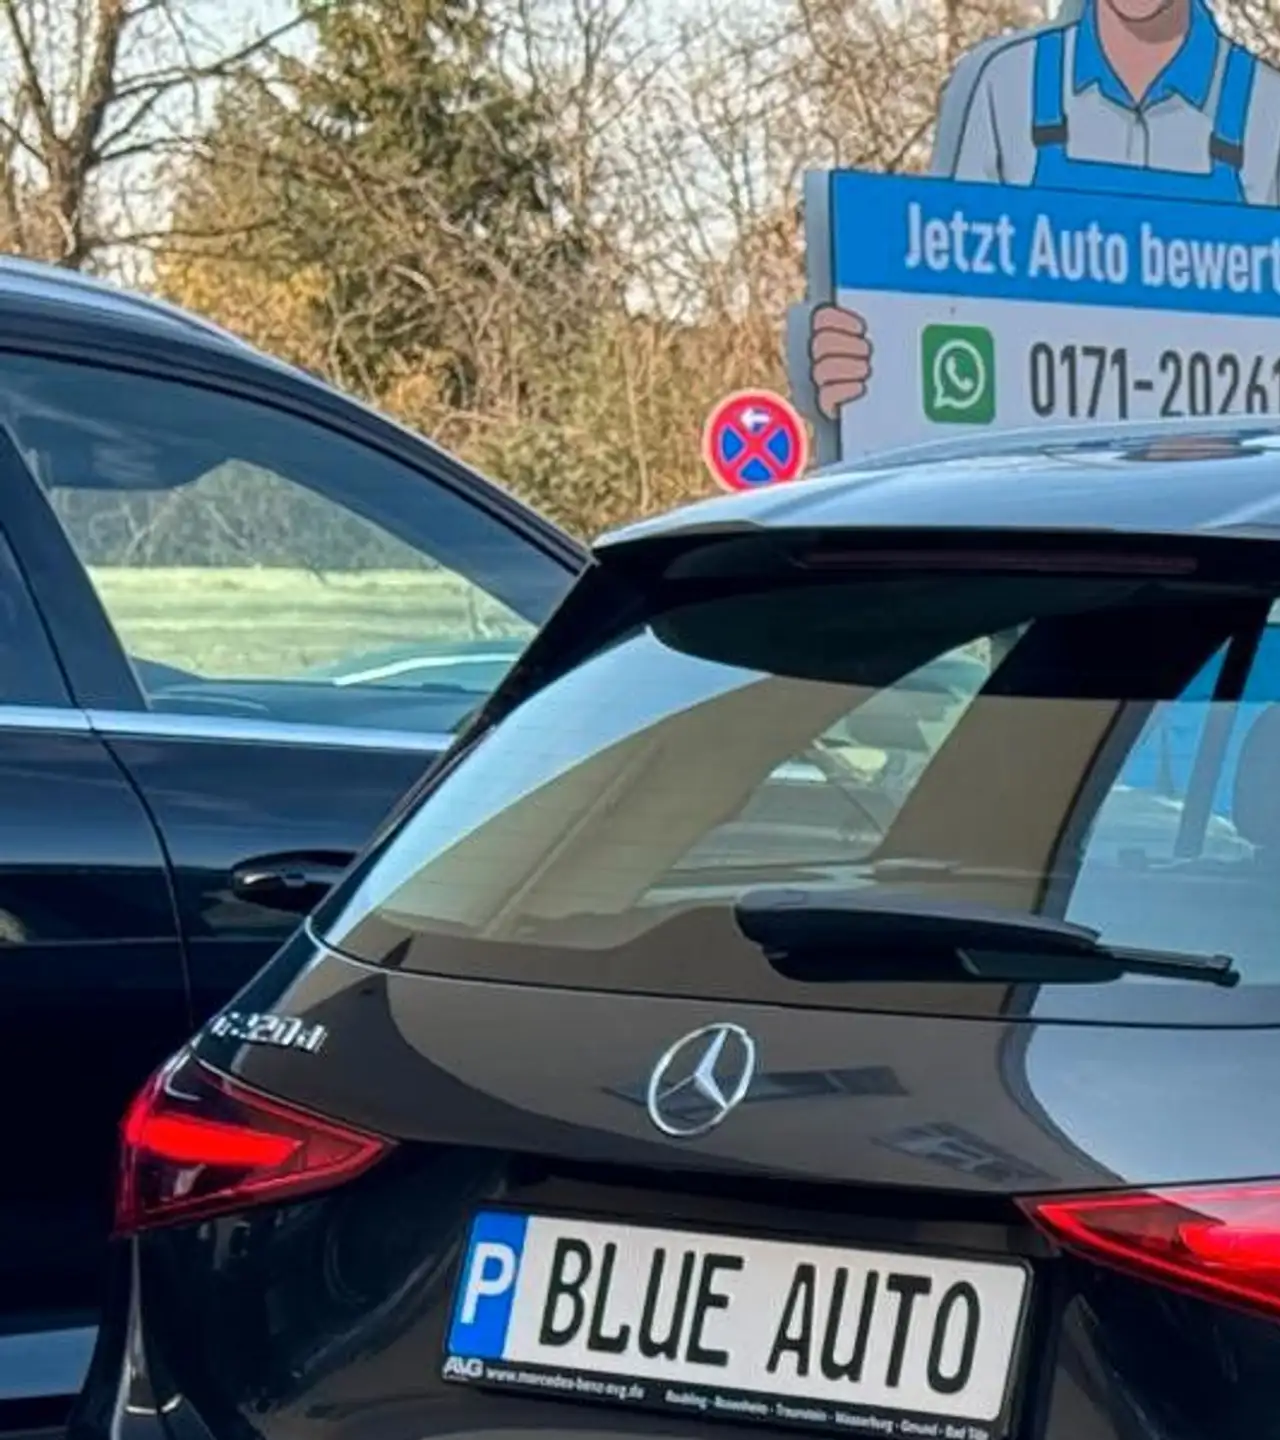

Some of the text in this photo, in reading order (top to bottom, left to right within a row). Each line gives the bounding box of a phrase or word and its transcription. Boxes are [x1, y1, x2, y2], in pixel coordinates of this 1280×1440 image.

[904, 201, 1016, 277] Jetzt
[1027, 212, 1126, 285] Auto
[459, 1241, 516, 1325] P
[538, 1237, 982, 1395] BLUE AUTO
